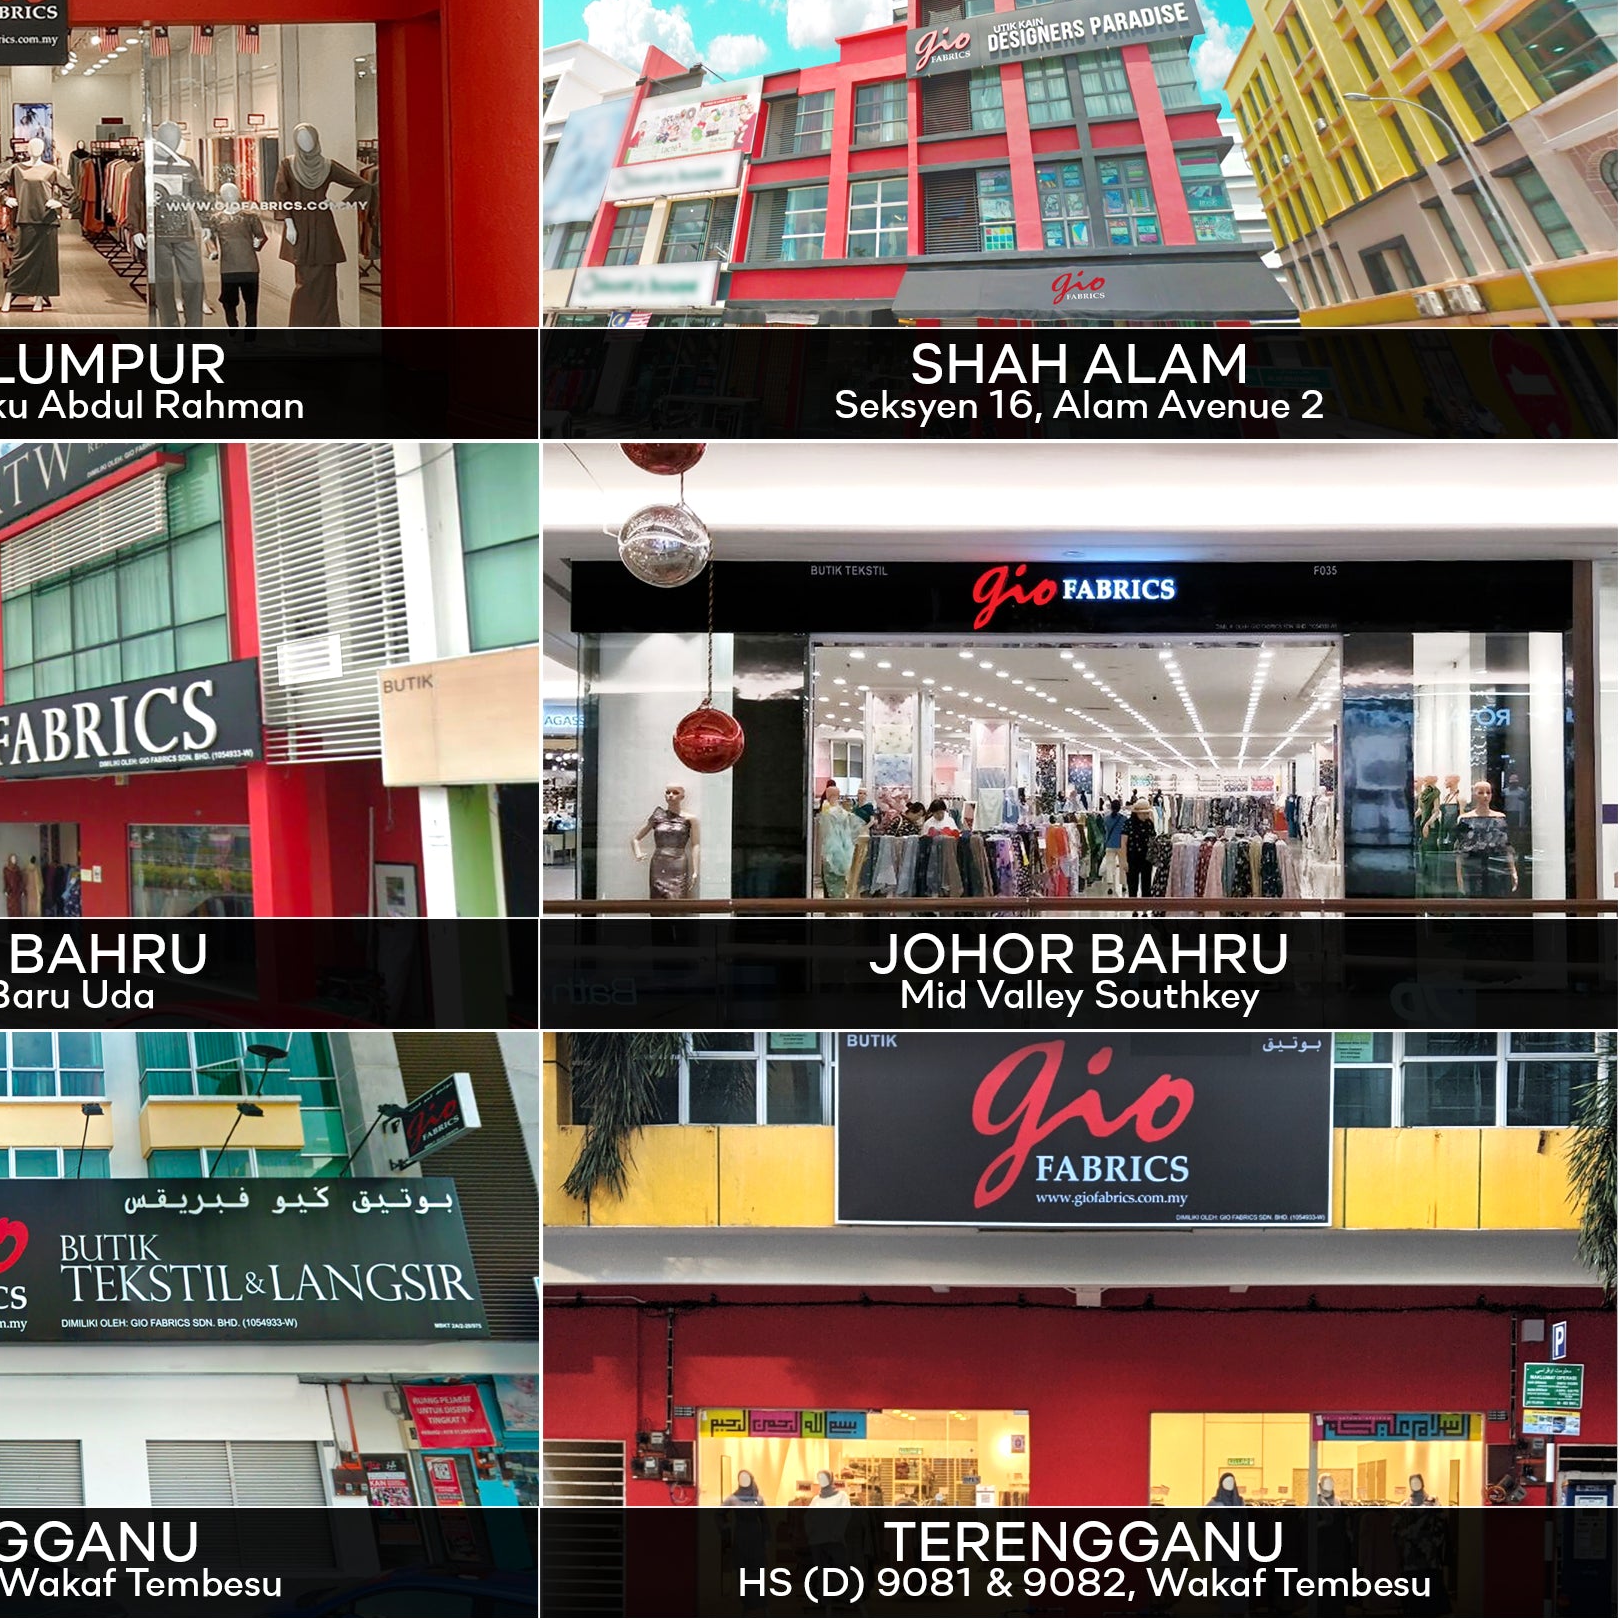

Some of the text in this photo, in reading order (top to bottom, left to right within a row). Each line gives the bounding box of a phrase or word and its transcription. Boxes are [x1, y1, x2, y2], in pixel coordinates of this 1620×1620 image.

[987, 2, 1189, 53] DESIGNERS PARADISE
[1018, 16, 1044, 30] KAIN
[915, 26, 971, 72] gio
[931, 50, 971, 64] FABRICS
[1051, 270, 1105, 305] gio
[1066, 292, 1106, 300] FABRICS
[810, 565, 888, 577] BUTIK TEKSTIL
[1313, 566, 1338, 576] F035
[973, 564, 1176, 629] gio FABRICS
[383, 674, 433, 695] BUTIK
[139, 754, 177, 765] GIO FABRICS
[846, 1034, 898, 1048] BUTIK
[1262, 1037, 1322, 1054] بوتيق
[407, 1099, 457, 1154] gio
[422, 1114, 460, 1141] FABRICS
[972, 1039, 1195, 1209] gio
[1036, 1155, 1189, 1183] FABRICS
[125, 1186, 454, 1215] بوتيق فبريقس
[1036, 1191, 1189, 1207] www.giofabrics.com.my
[60, 1233, 161, 1262] BUTIK
[60, 1263, 475, 1302] TEKSTIL & LANGSIR
[61, 1318, 298, 1329] DIMILIKI OLEH: GIO FABRICS SDN. BHD. (1054933-W)
[1555, 1325, 1564, 1357] P
[427, 1416, 460, 1425] TINGKAT
